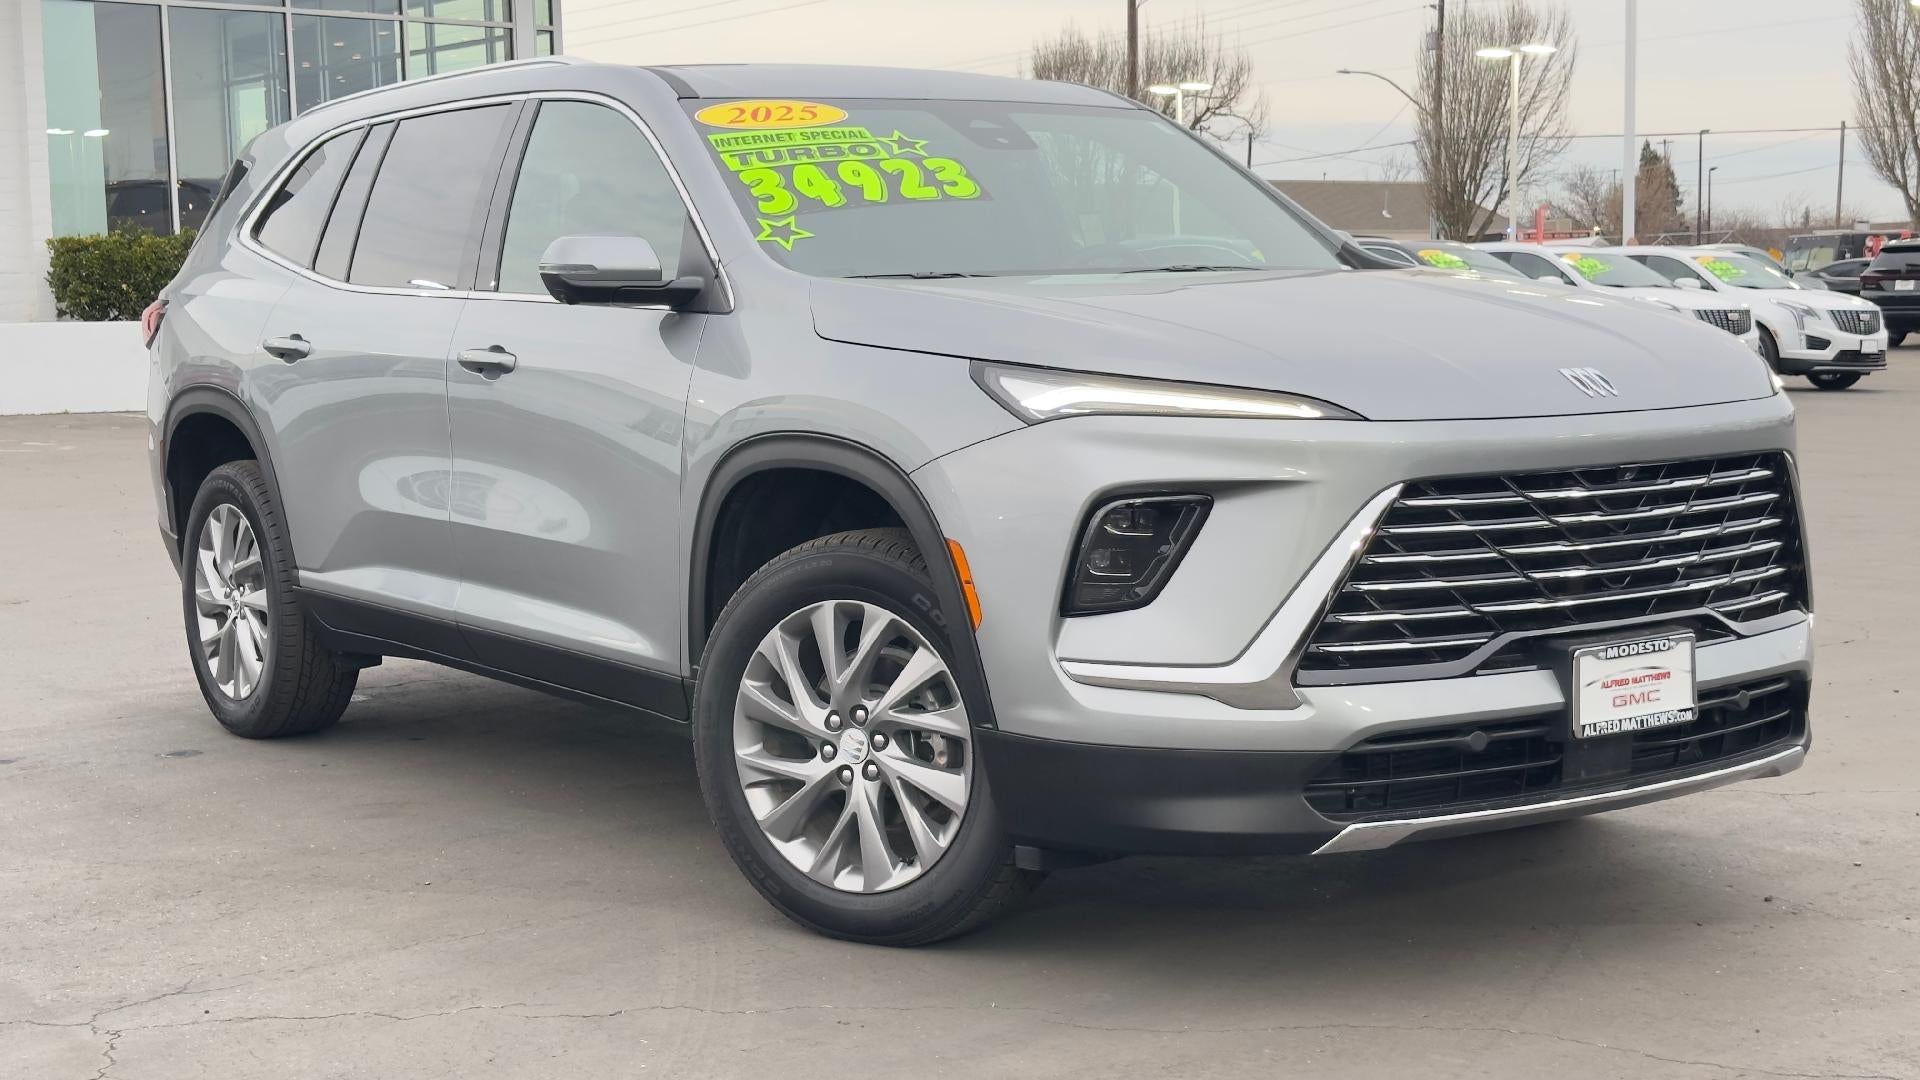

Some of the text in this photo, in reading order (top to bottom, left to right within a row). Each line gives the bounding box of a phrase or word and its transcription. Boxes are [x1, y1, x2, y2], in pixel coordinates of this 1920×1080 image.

[727, 104, 818, 125] 2025
[713, 129, 869, 149] INTERNET SPECIAL
[729, 143, 880, 168] TURBO
[739, 158, 981, 216] 34923
[1606, 639, 1670, 659] MODESTO
[1601, 671, 1671, 689] ALFRED MATTHEWS
[1612, 689, 1661, 708] GMC
